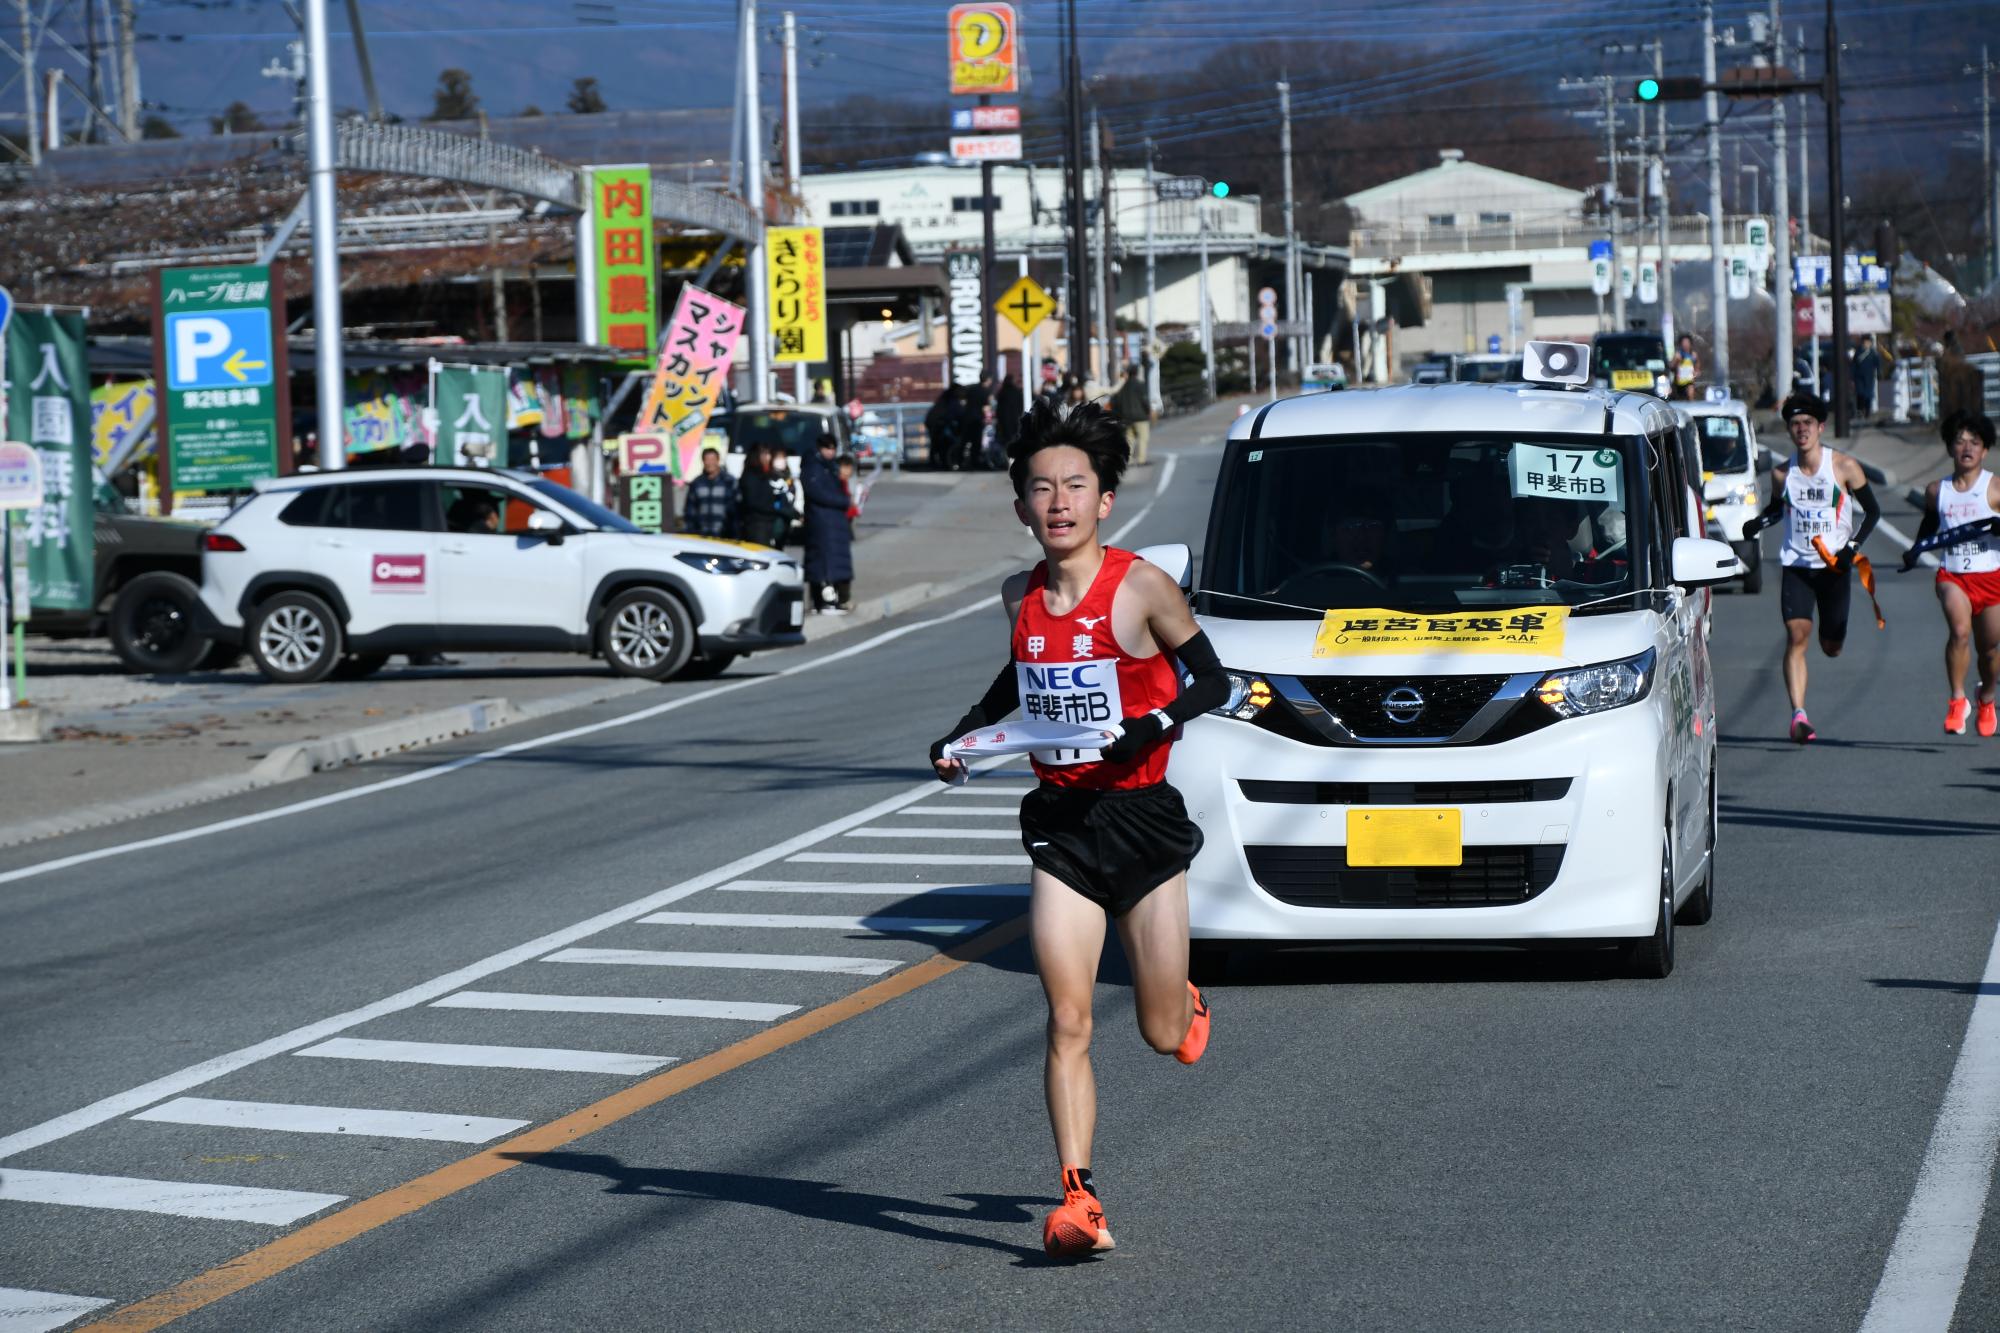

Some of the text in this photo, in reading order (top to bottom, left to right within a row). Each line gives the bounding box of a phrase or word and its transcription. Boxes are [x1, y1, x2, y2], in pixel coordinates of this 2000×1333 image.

[175, 318, 232, 383] P
[652, 300, 710, 424] マスカット
[685, 312, 736, 407] シャイン
[183, 388, 260, 409] 第2駐車場
[627, 438, 664, 472] P
[1546, 454, 1583, 473] 17
[1527, 472, 1606, 494] 甲斐市B
[1796, 488, 1825, 501] 上野原
[630, 476, 662, 534] 内田
[1796, 510, 1826, 519] NEC
[1795, 520, 1832, 533] 上野原市
[1963, 558, 1971, 570] 2
[1027, 634, 1094, 660] 甲斐
[1026, 664, 1101, 690] NEC
[1026, 692, 1111, 725] 甲斐市B
